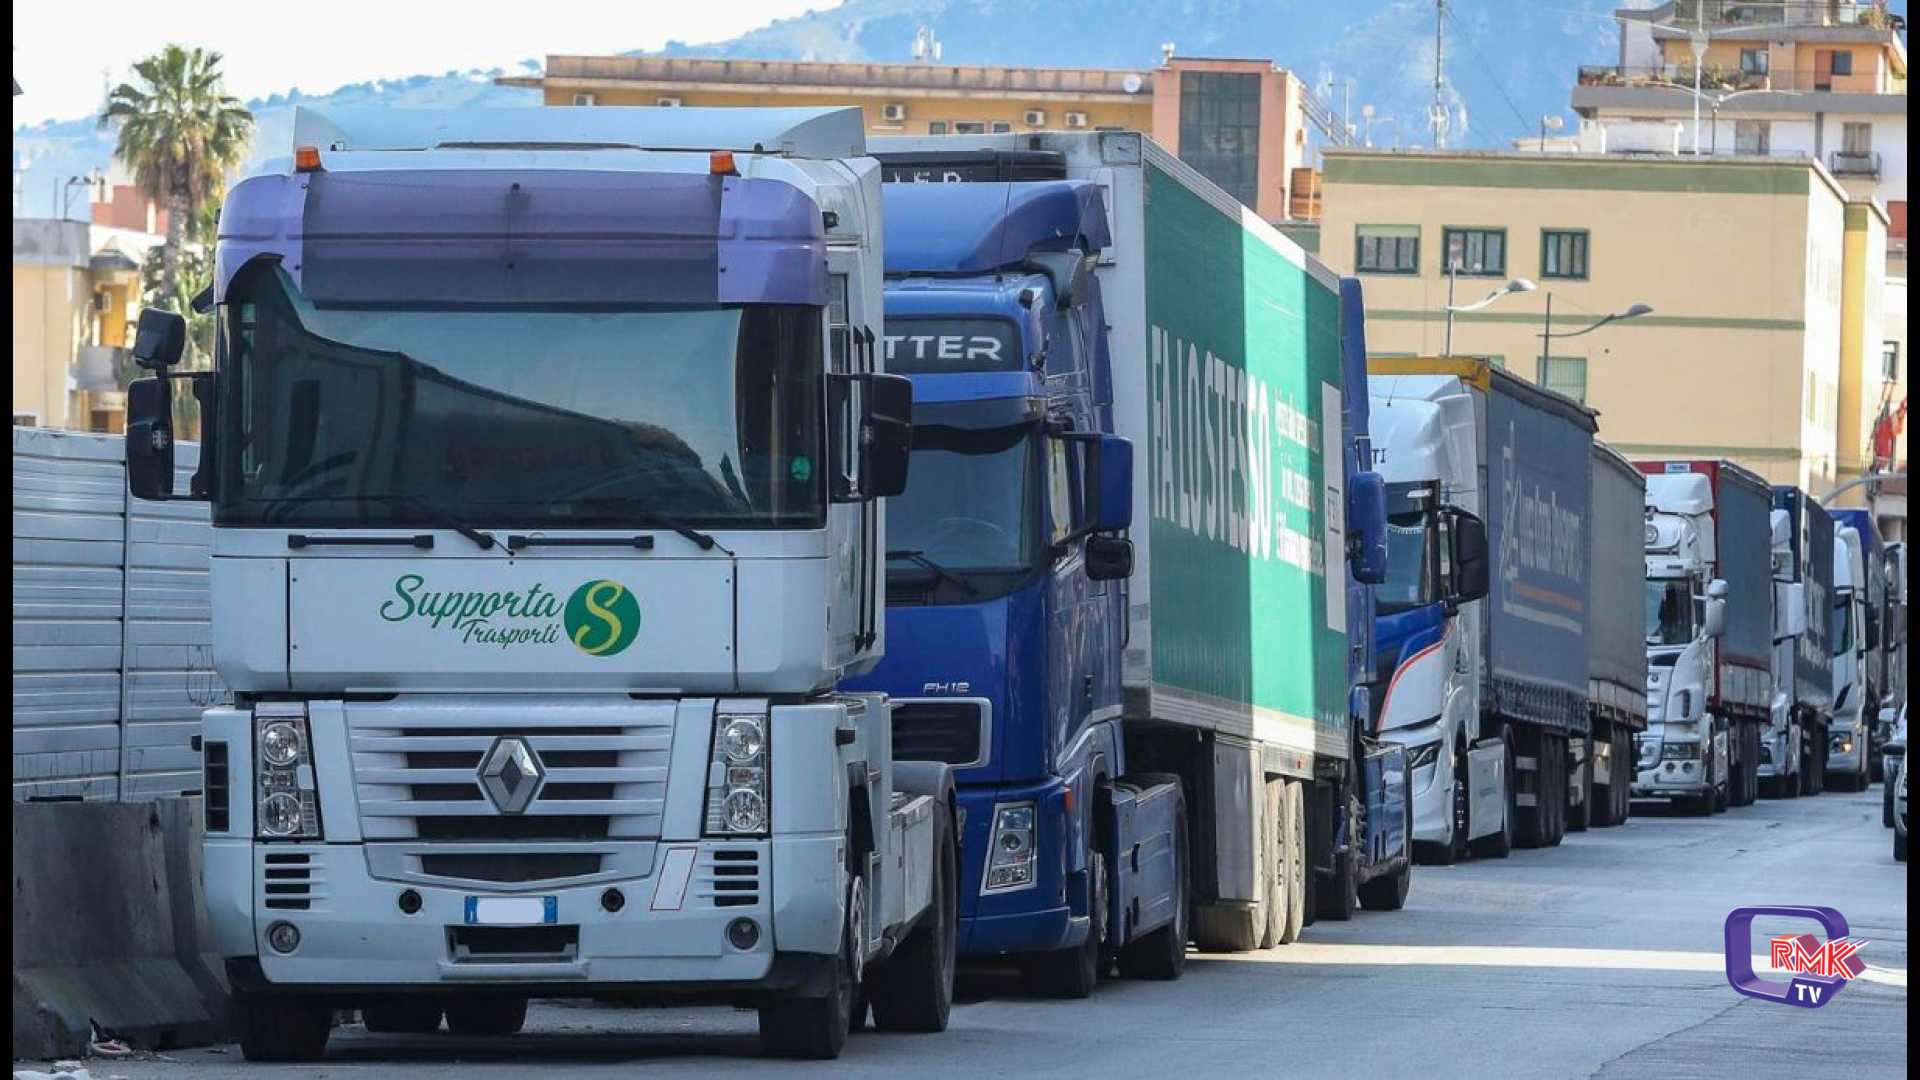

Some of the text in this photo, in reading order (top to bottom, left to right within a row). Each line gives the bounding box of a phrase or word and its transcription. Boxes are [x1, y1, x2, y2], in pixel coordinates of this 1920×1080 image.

[380, 574, 562, 628] Supporta
[460, 618, 560, 649] Trasporti
[923, 681, 970, 694] FH12
